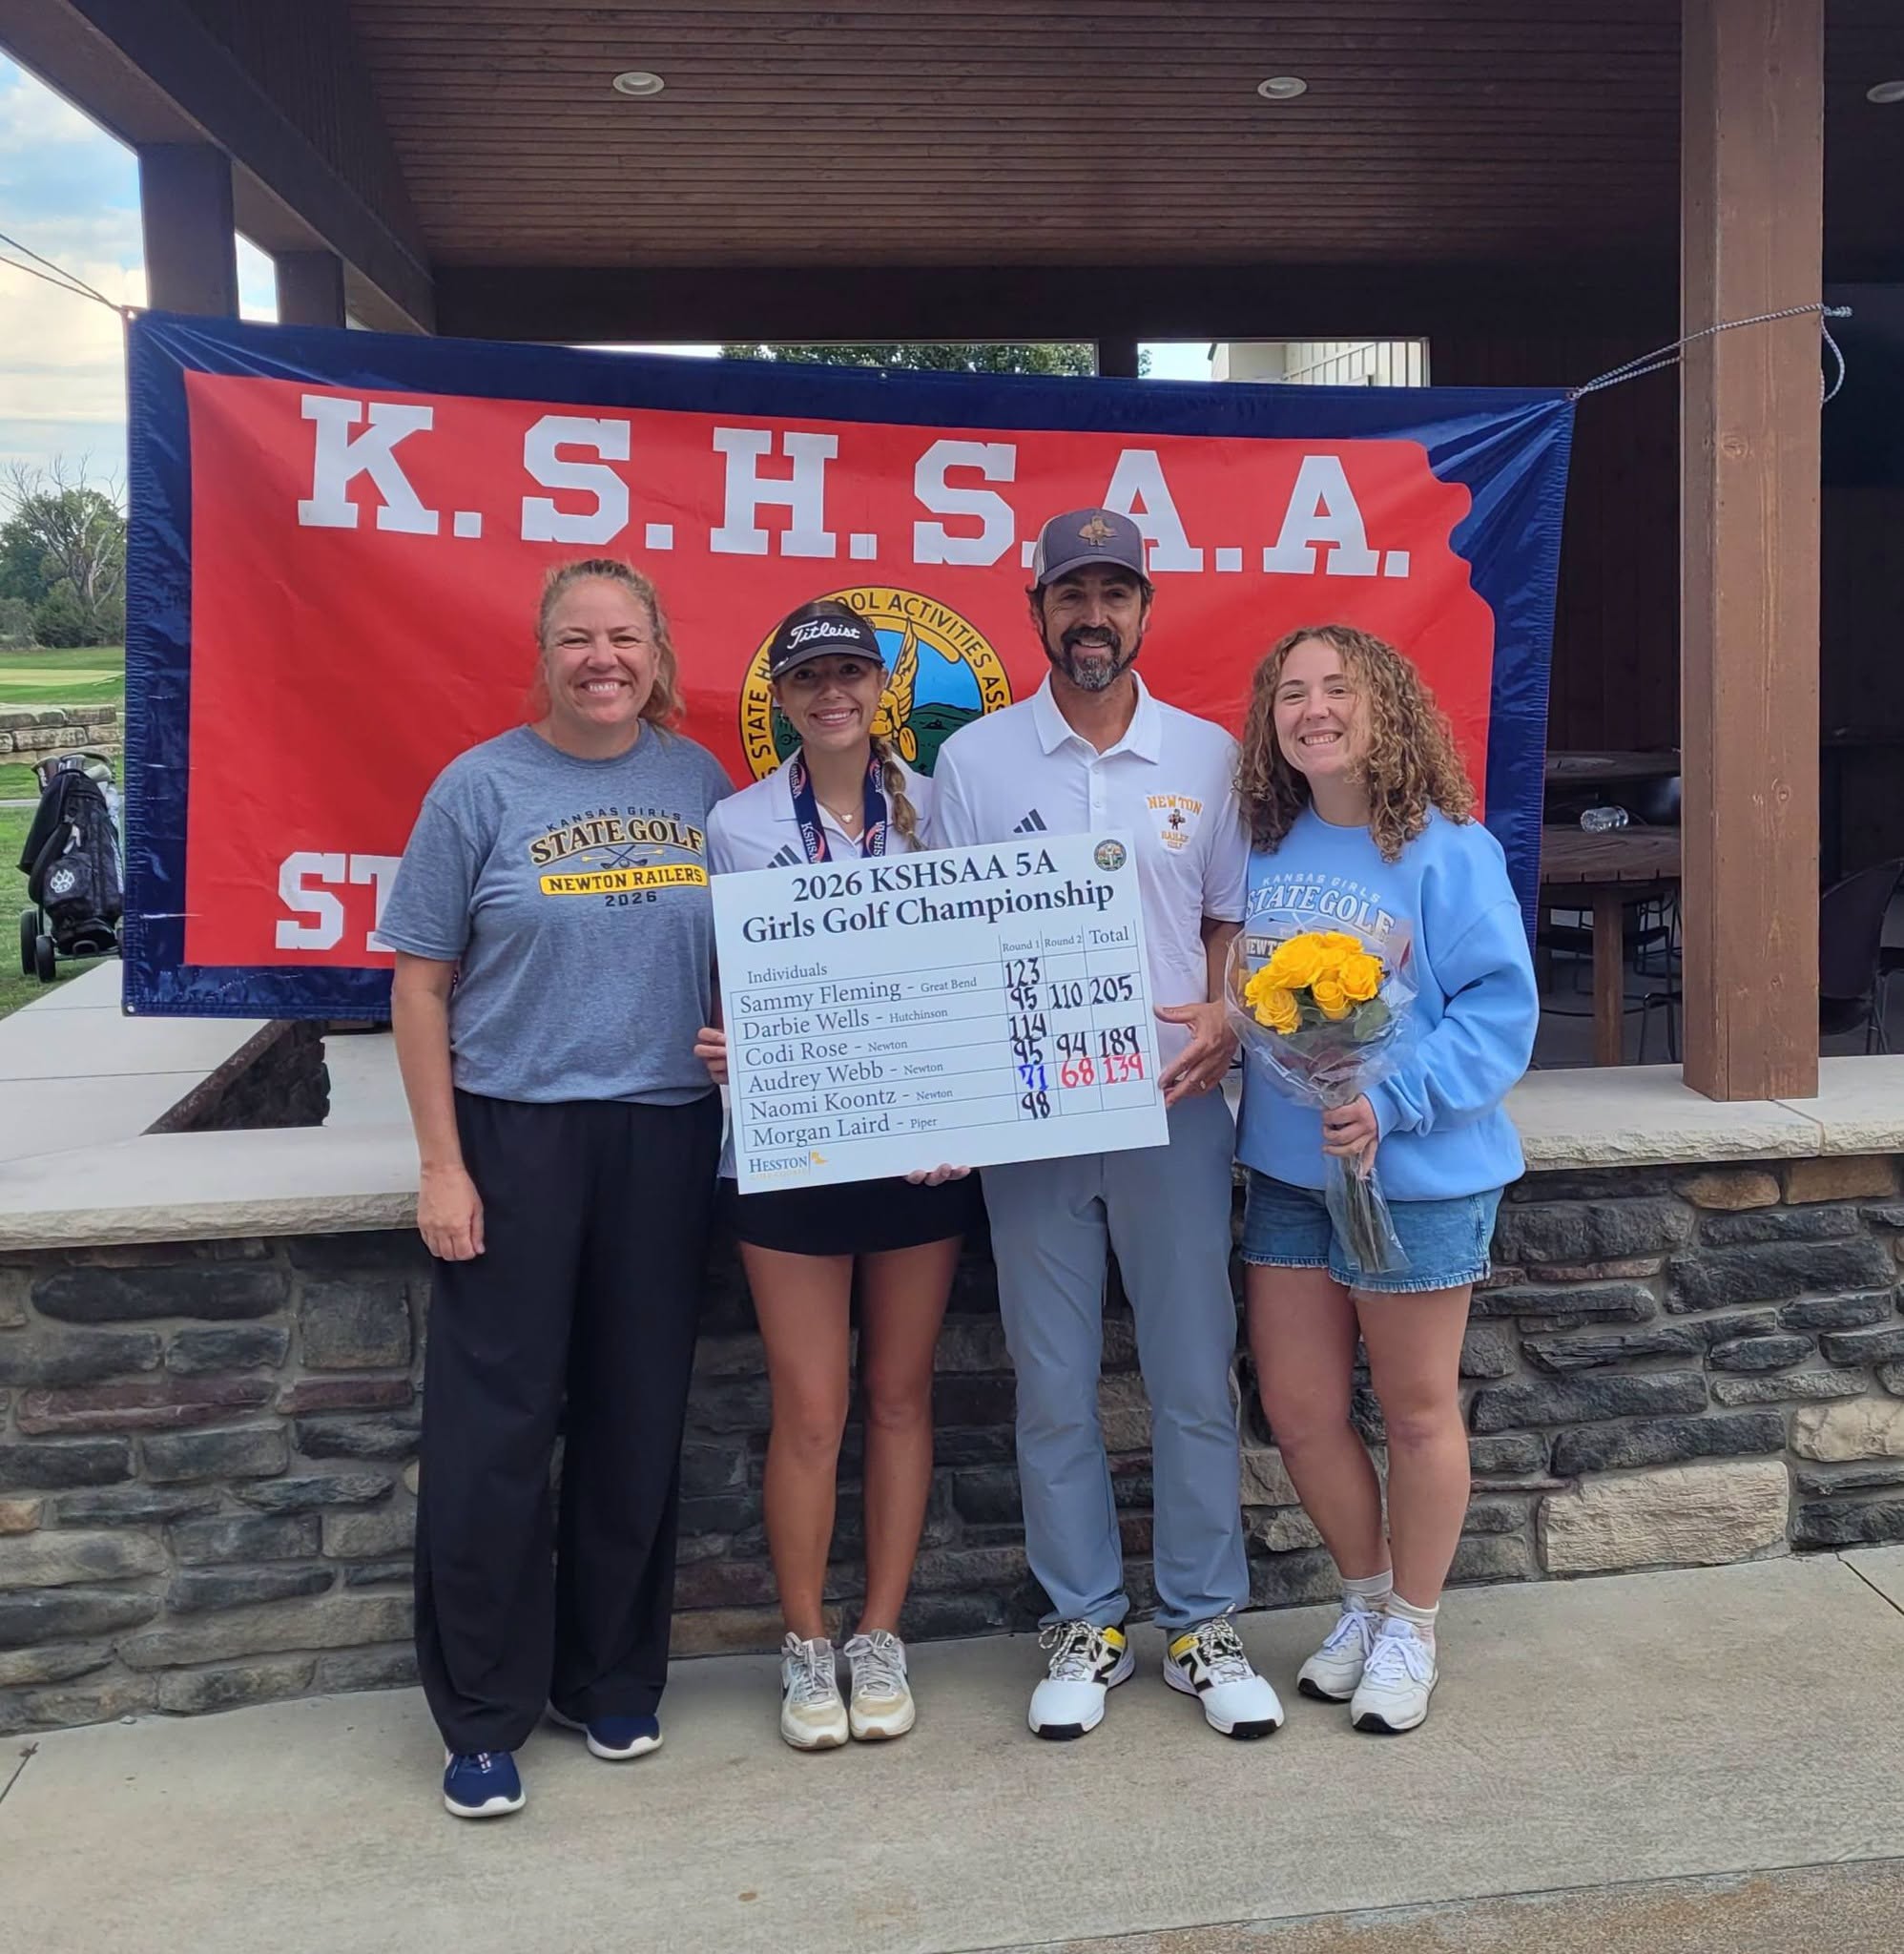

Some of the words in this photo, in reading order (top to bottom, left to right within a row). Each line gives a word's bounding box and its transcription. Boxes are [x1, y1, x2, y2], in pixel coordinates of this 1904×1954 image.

[787, 620, 861, 650] Titleist
[748, 689, 771, 759] STATE
[888, 593, 992, 669] ACTIVITIES
[546, 807, 619, 832] KANSAS
[628, 805, 682, 821] GIRLS
[1146, 794, 1203, 816] NEWTON
[529, 818, 625, 864] STATE
[628, 817, 704, 852] GOLF
[549, 872, 628, 891] NEWTON
[633, 867, 703, 885] RAILERS
[792, 871, 862, 903] 2026
[871, 855, 1008, 893] KSHSAA
[1016, 848, 1059, 876] 5A
[1263, 873, 1326, 886] KANSAS
[1332, 876, 1381, 904] GIRLS
[605, 890, 657, 906] 2026
[742, 913, 816, 943] Girls
[822, 903, 890, 935] Golf
[896, 879, 1115, 925] Championship
[1319, 889, 1397, 943] GOLF
[1003, 940, 1033, 953] Round
[1045, 936, 1075, 948] Round
[1089, 925, 1129, 945] Total
[747, 963, 828, 985] Individuals
[1005, 957, 1040, 988] 123
[740, 992, 814, 1014] Sammy
[819, 982, 901, 1004] Fleming
[921, 981, 949, 993] Great
[951, 977, 977, 990] Bend
[1010, 987, 1038, 1011] 95
[1049, 982, 1084, 1009] 110
[1090, 974, 1133, 1005] 205
[743, 1017, 810, 1040] Darbie
[816, 1008, 869, 1031] Wells
[889, 1009, 948, 1024] Hutchinson
[1009, 1013, 1047, 1041] 114
[745, 1044, 794, 1067] Codi
[801, 1042, 848, 1060] Rose
[868, 1040, 908, 1052] Newton
[1013, 1037, 1043, 1065] 95
[1056, 1031, 1087, 1059] 94
[1099, 1026, 1141, 1057] 189
[748, 1071, 821, 1093] Audrey
[826, 1061, 883, 1084] Webb
[903, 1063, 943, 1075] Newton
[1018, 1064, 1049, 1091] 71
[1061, 1057, 1094, 1089] 68
[1103, 1053, 1144, 1084] 139
[750, 1097, 817, 1120] Naomi
[824, 1089, 897, 1112] Koontz
[916, 1089, 954, 1101] Newton
[1022, 1091, 1050, 1120] 98
[753, 1124, 831, 1148] Morgan
[837, 1113, 890, 1137] Laird
[910, 1116, 939, 1131] Piper
[749, 1156, 808, 1173] HESSTON
